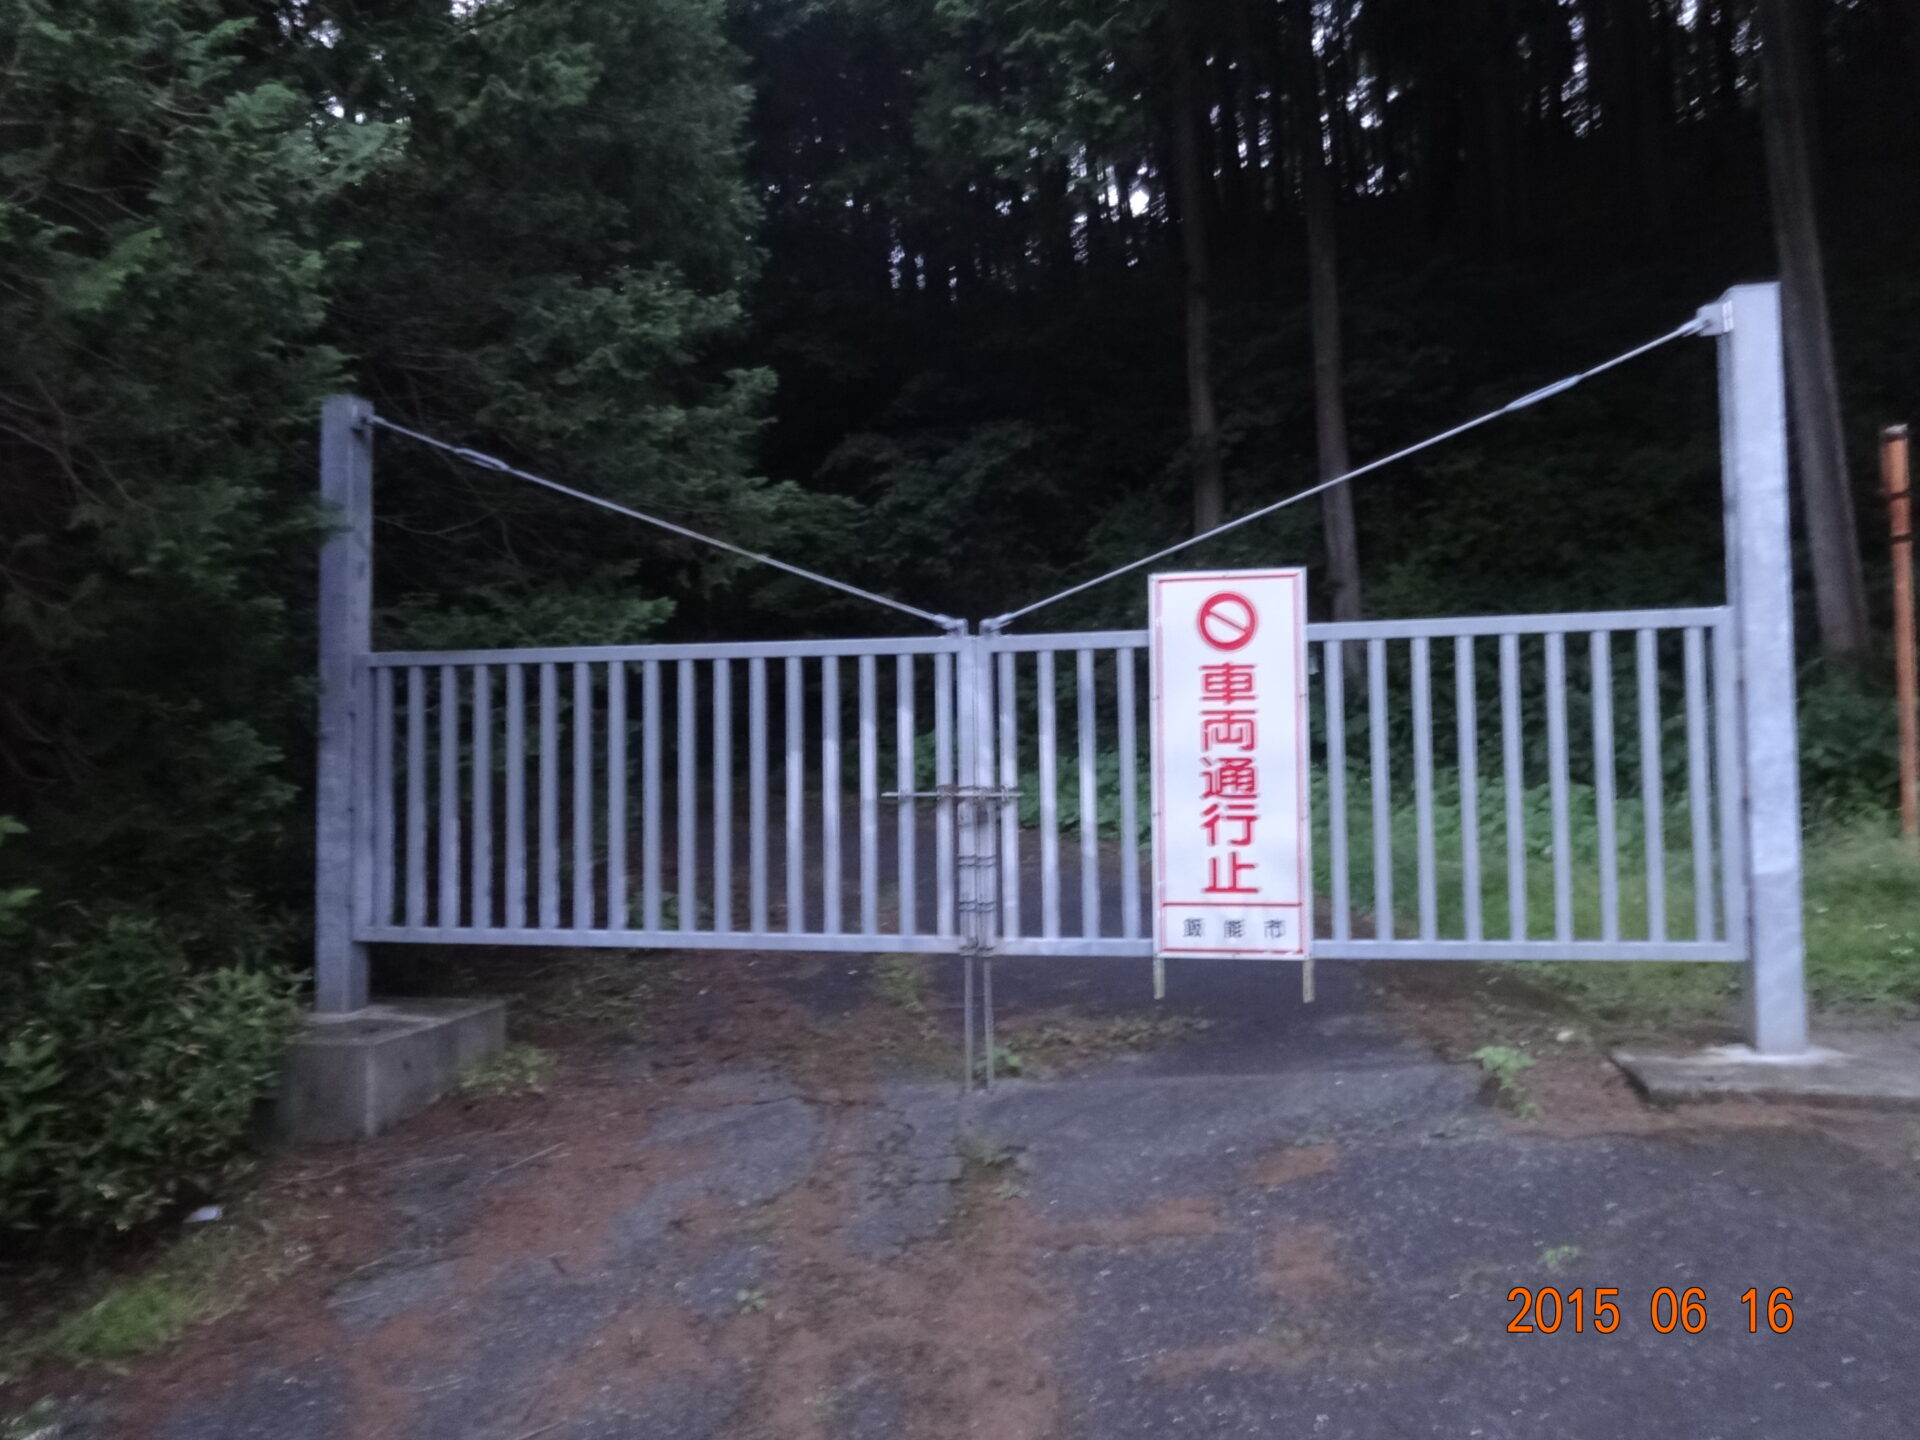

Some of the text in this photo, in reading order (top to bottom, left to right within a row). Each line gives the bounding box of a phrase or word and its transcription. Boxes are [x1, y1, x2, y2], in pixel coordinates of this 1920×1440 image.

[1198, 662, 1260, 894] 車両通行止
